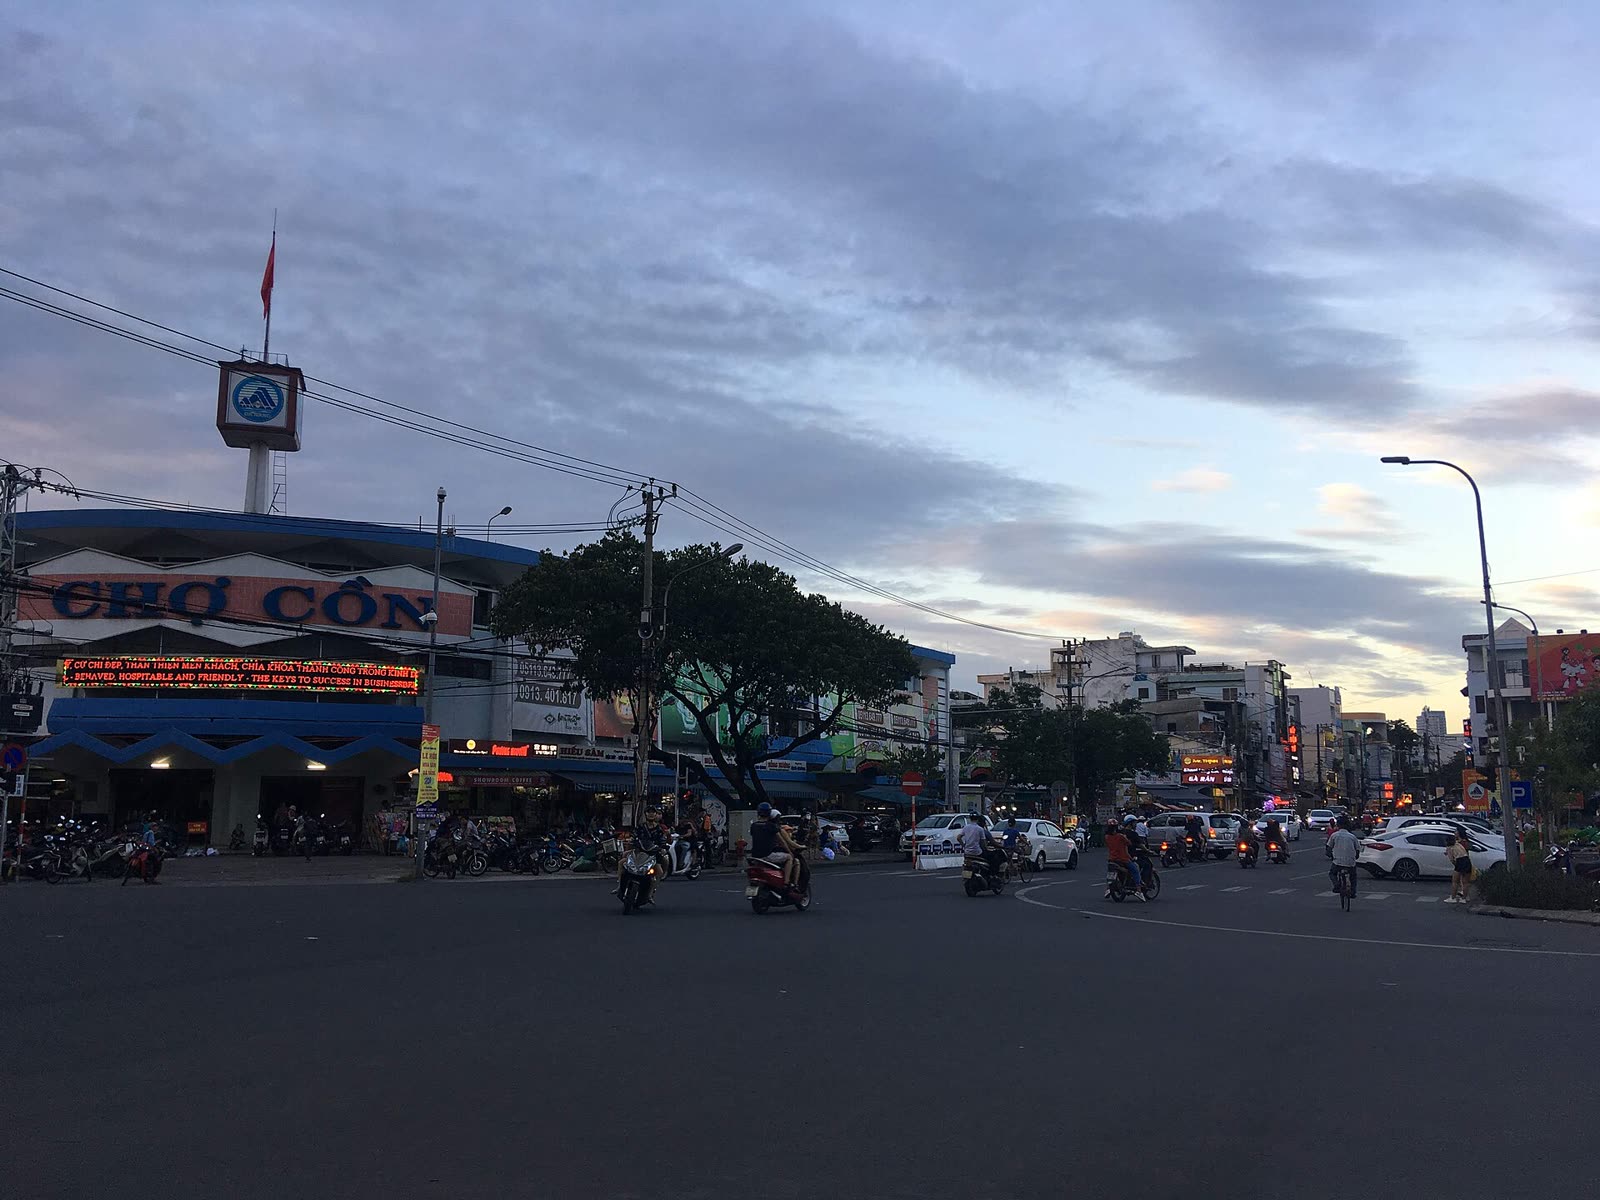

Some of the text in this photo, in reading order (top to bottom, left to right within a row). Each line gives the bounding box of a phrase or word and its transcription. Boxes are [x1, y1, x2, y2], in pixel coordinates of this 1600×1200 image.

[53, 576, 434, 630] CHỢ CỒN
[119, 672, 175, 681] HOSPITABLE
[176, 673, 196, 681] AND
[198, 673, 244, 682] FRIENDLY
[251, 674, 270, 682] THE
[271, 675, 297, 683] KEYS
[298, 676, 312, 684] TO
[313, 676, 351, 686] SUCCESS
[353, 678, 363, 686] IN
[1512, 786, 1526, 802] P
